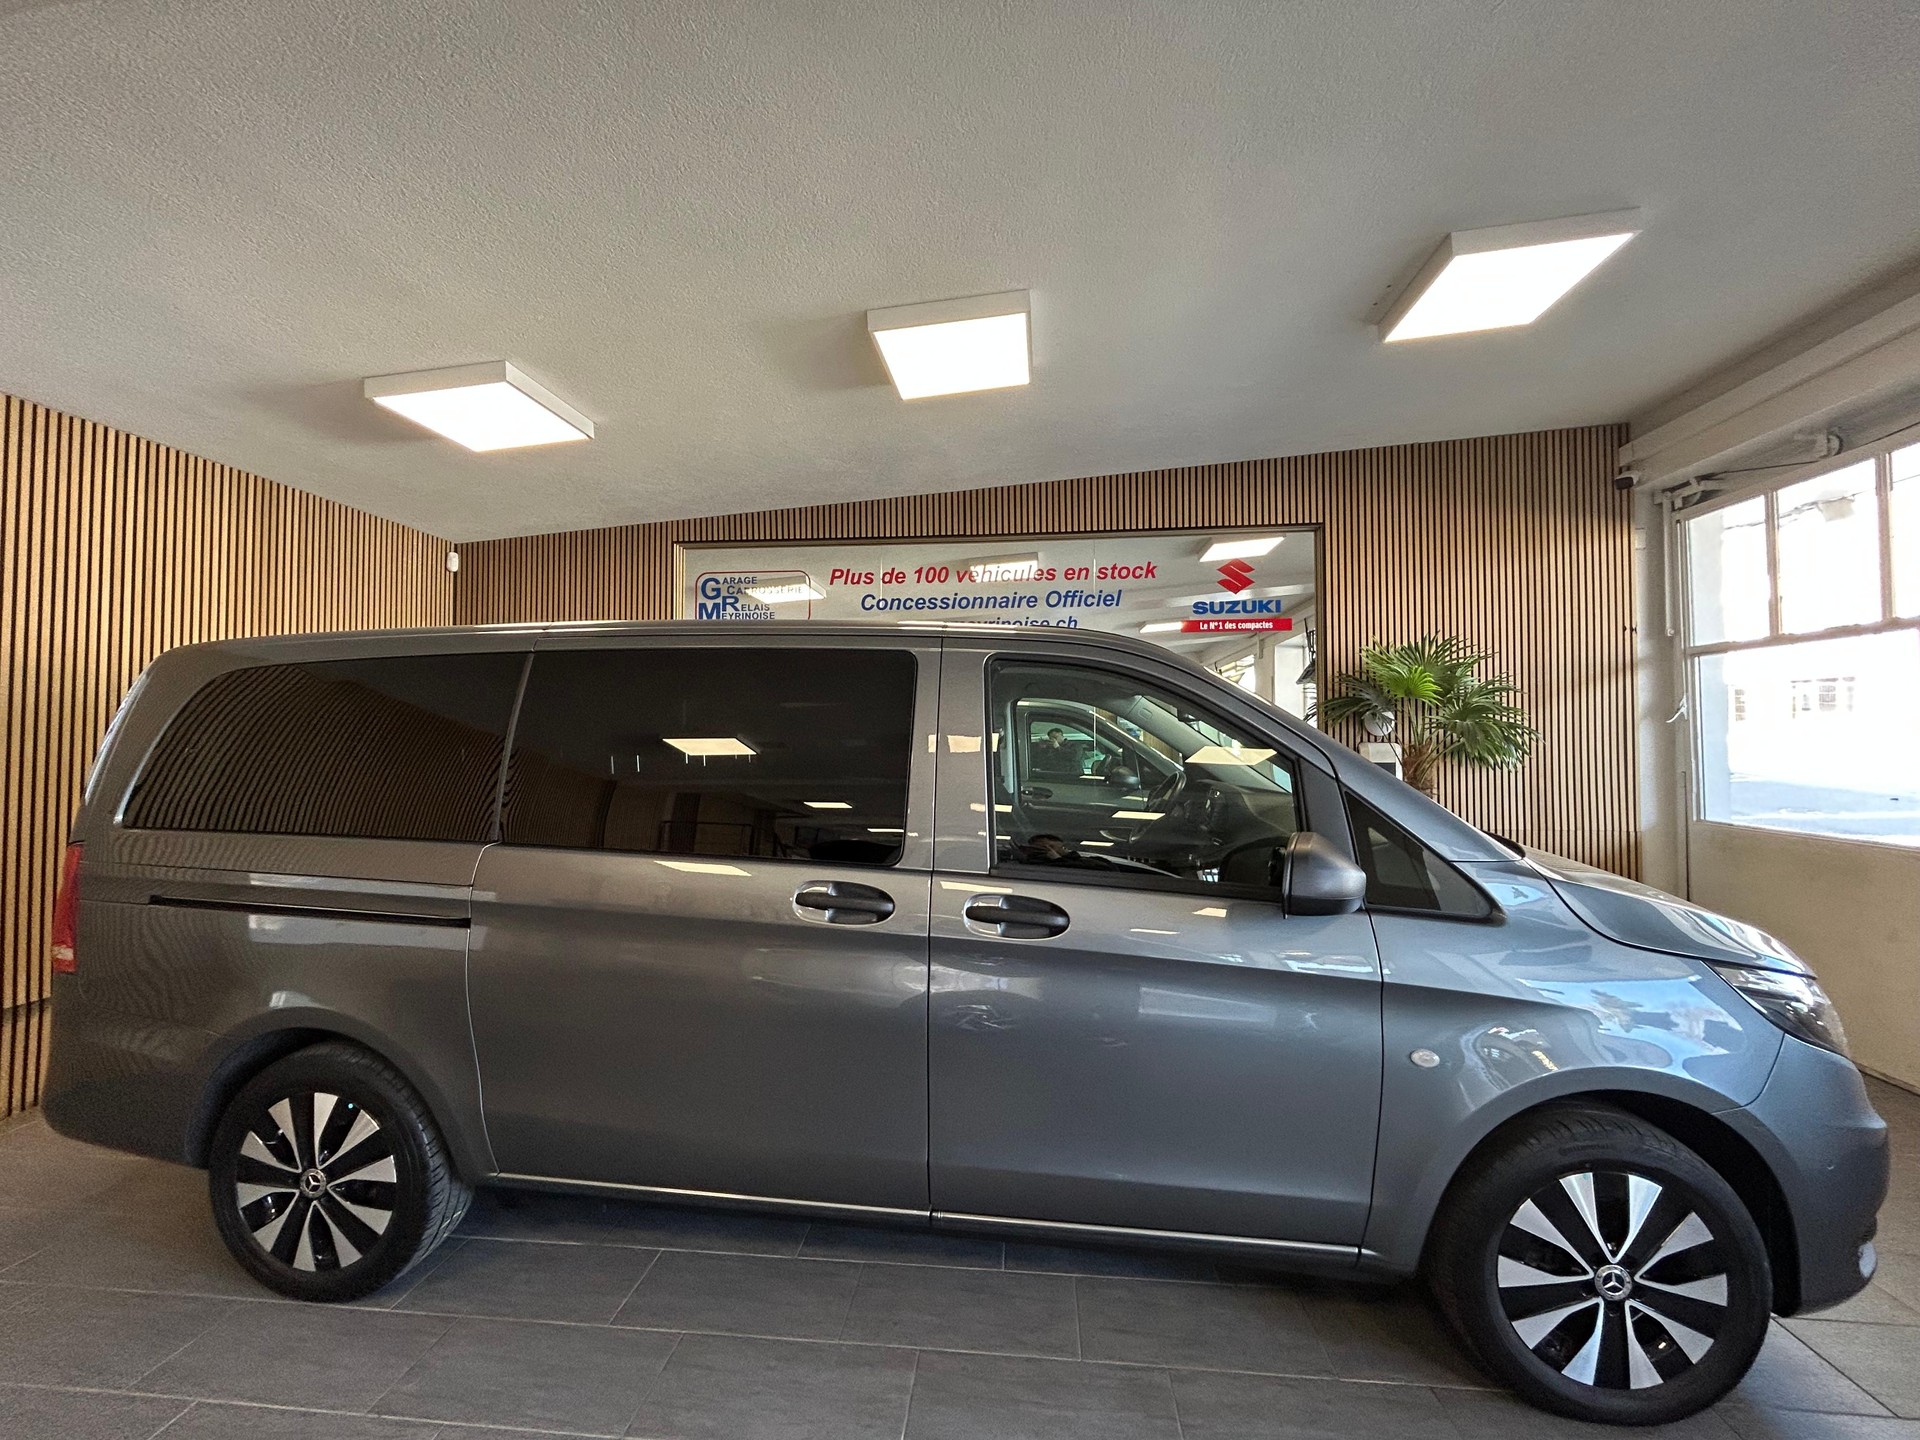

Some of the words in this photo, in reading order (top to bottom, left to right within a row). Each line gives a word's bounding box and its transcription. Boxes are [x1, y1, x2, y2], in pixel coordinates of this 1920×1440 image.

[829, 568, 875, 585] Plus
[881, 567, 906, 584] de
[914, 566, 950, 583] 100
[1063, 567, 1090, 580] en
[1096, 561, 1157, 580] stock
[861, 592, 1038, 611] Concessionnaire
[1045, 589, 1122, 608] Officiel
[1192, 599, 1281, 615] SUZUKI
[1200, 622, 1208, 630] Le
[1224, 621, 1236, 630] des
[1237, 621, 1273, 631] compactes
